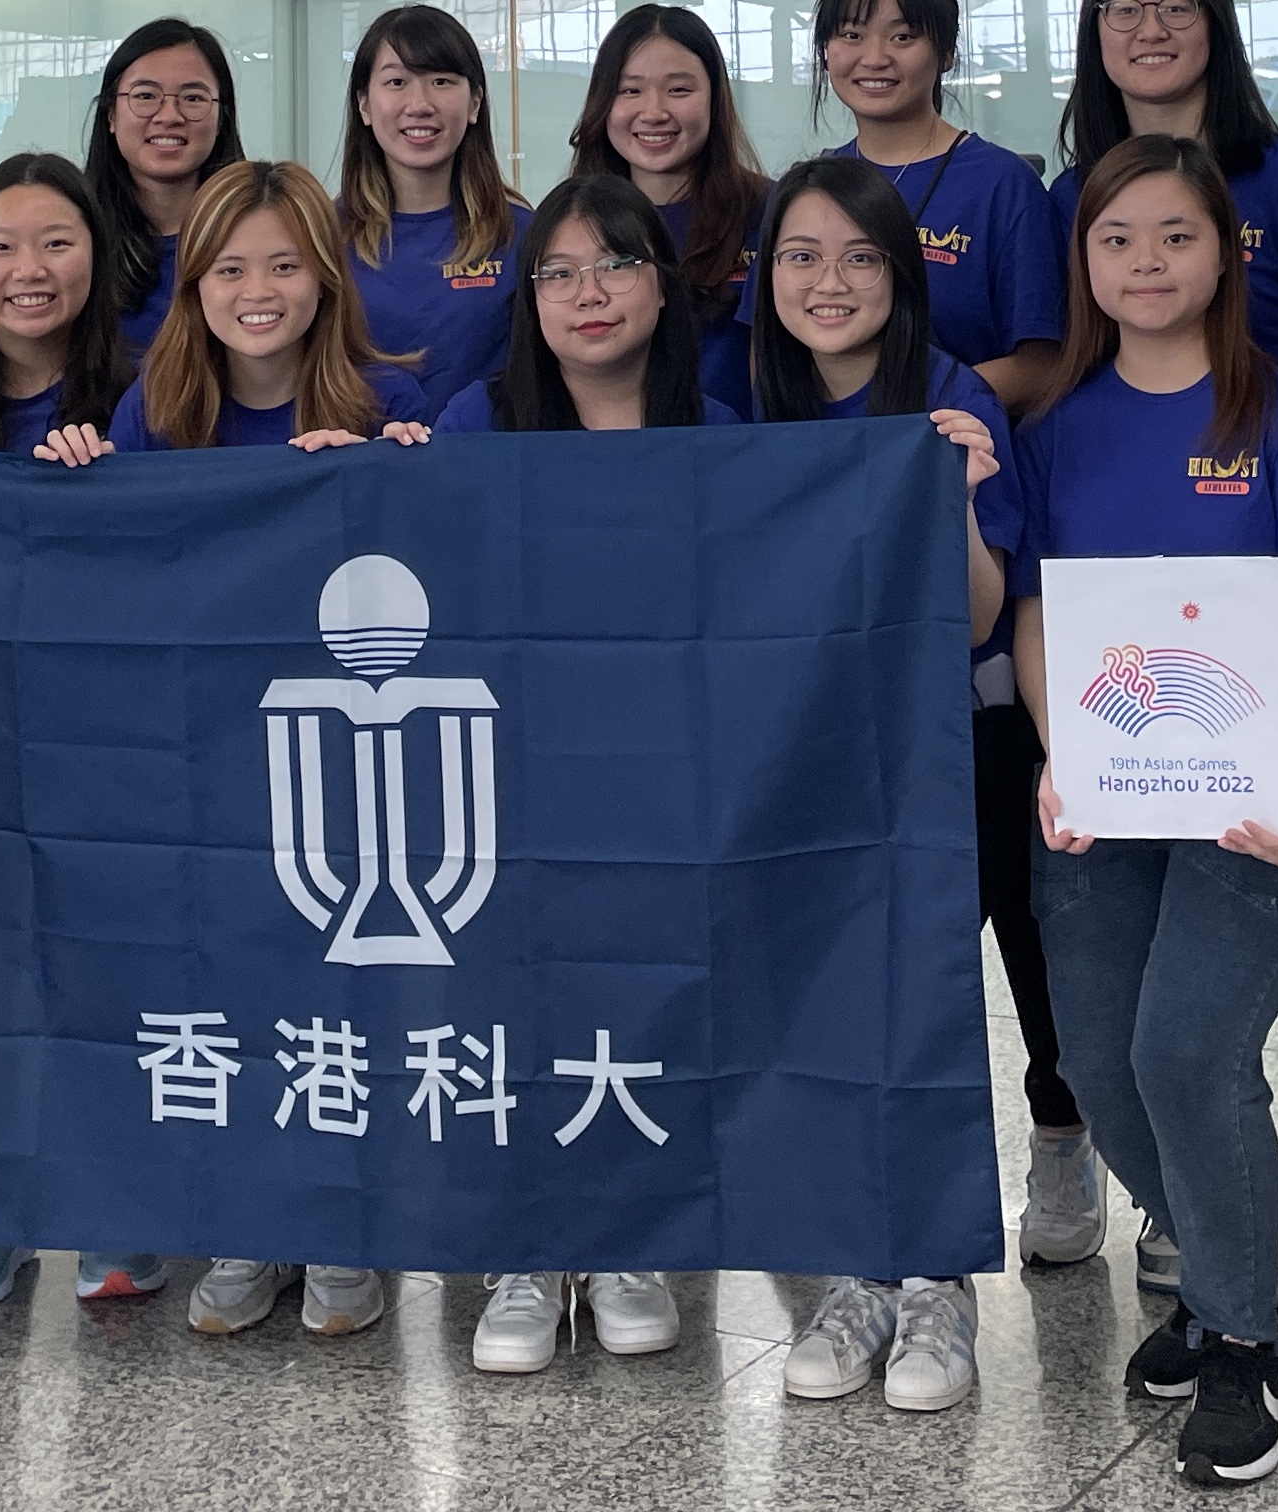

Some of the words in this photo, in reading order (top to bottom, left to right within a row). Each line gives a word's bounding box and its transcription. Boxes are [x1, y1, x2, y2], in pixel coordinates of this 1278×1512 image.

[1110, 757, 1140, 770] 19th
[1144, 757, 1184, 770] Asian
[1188, 757, 1237, 771] Games
[1099, 775, 1199, 795] Hangzhou
[1206, 776, 1255, 793] 2022
[135, 1010, 671, 1147] 香港科大
